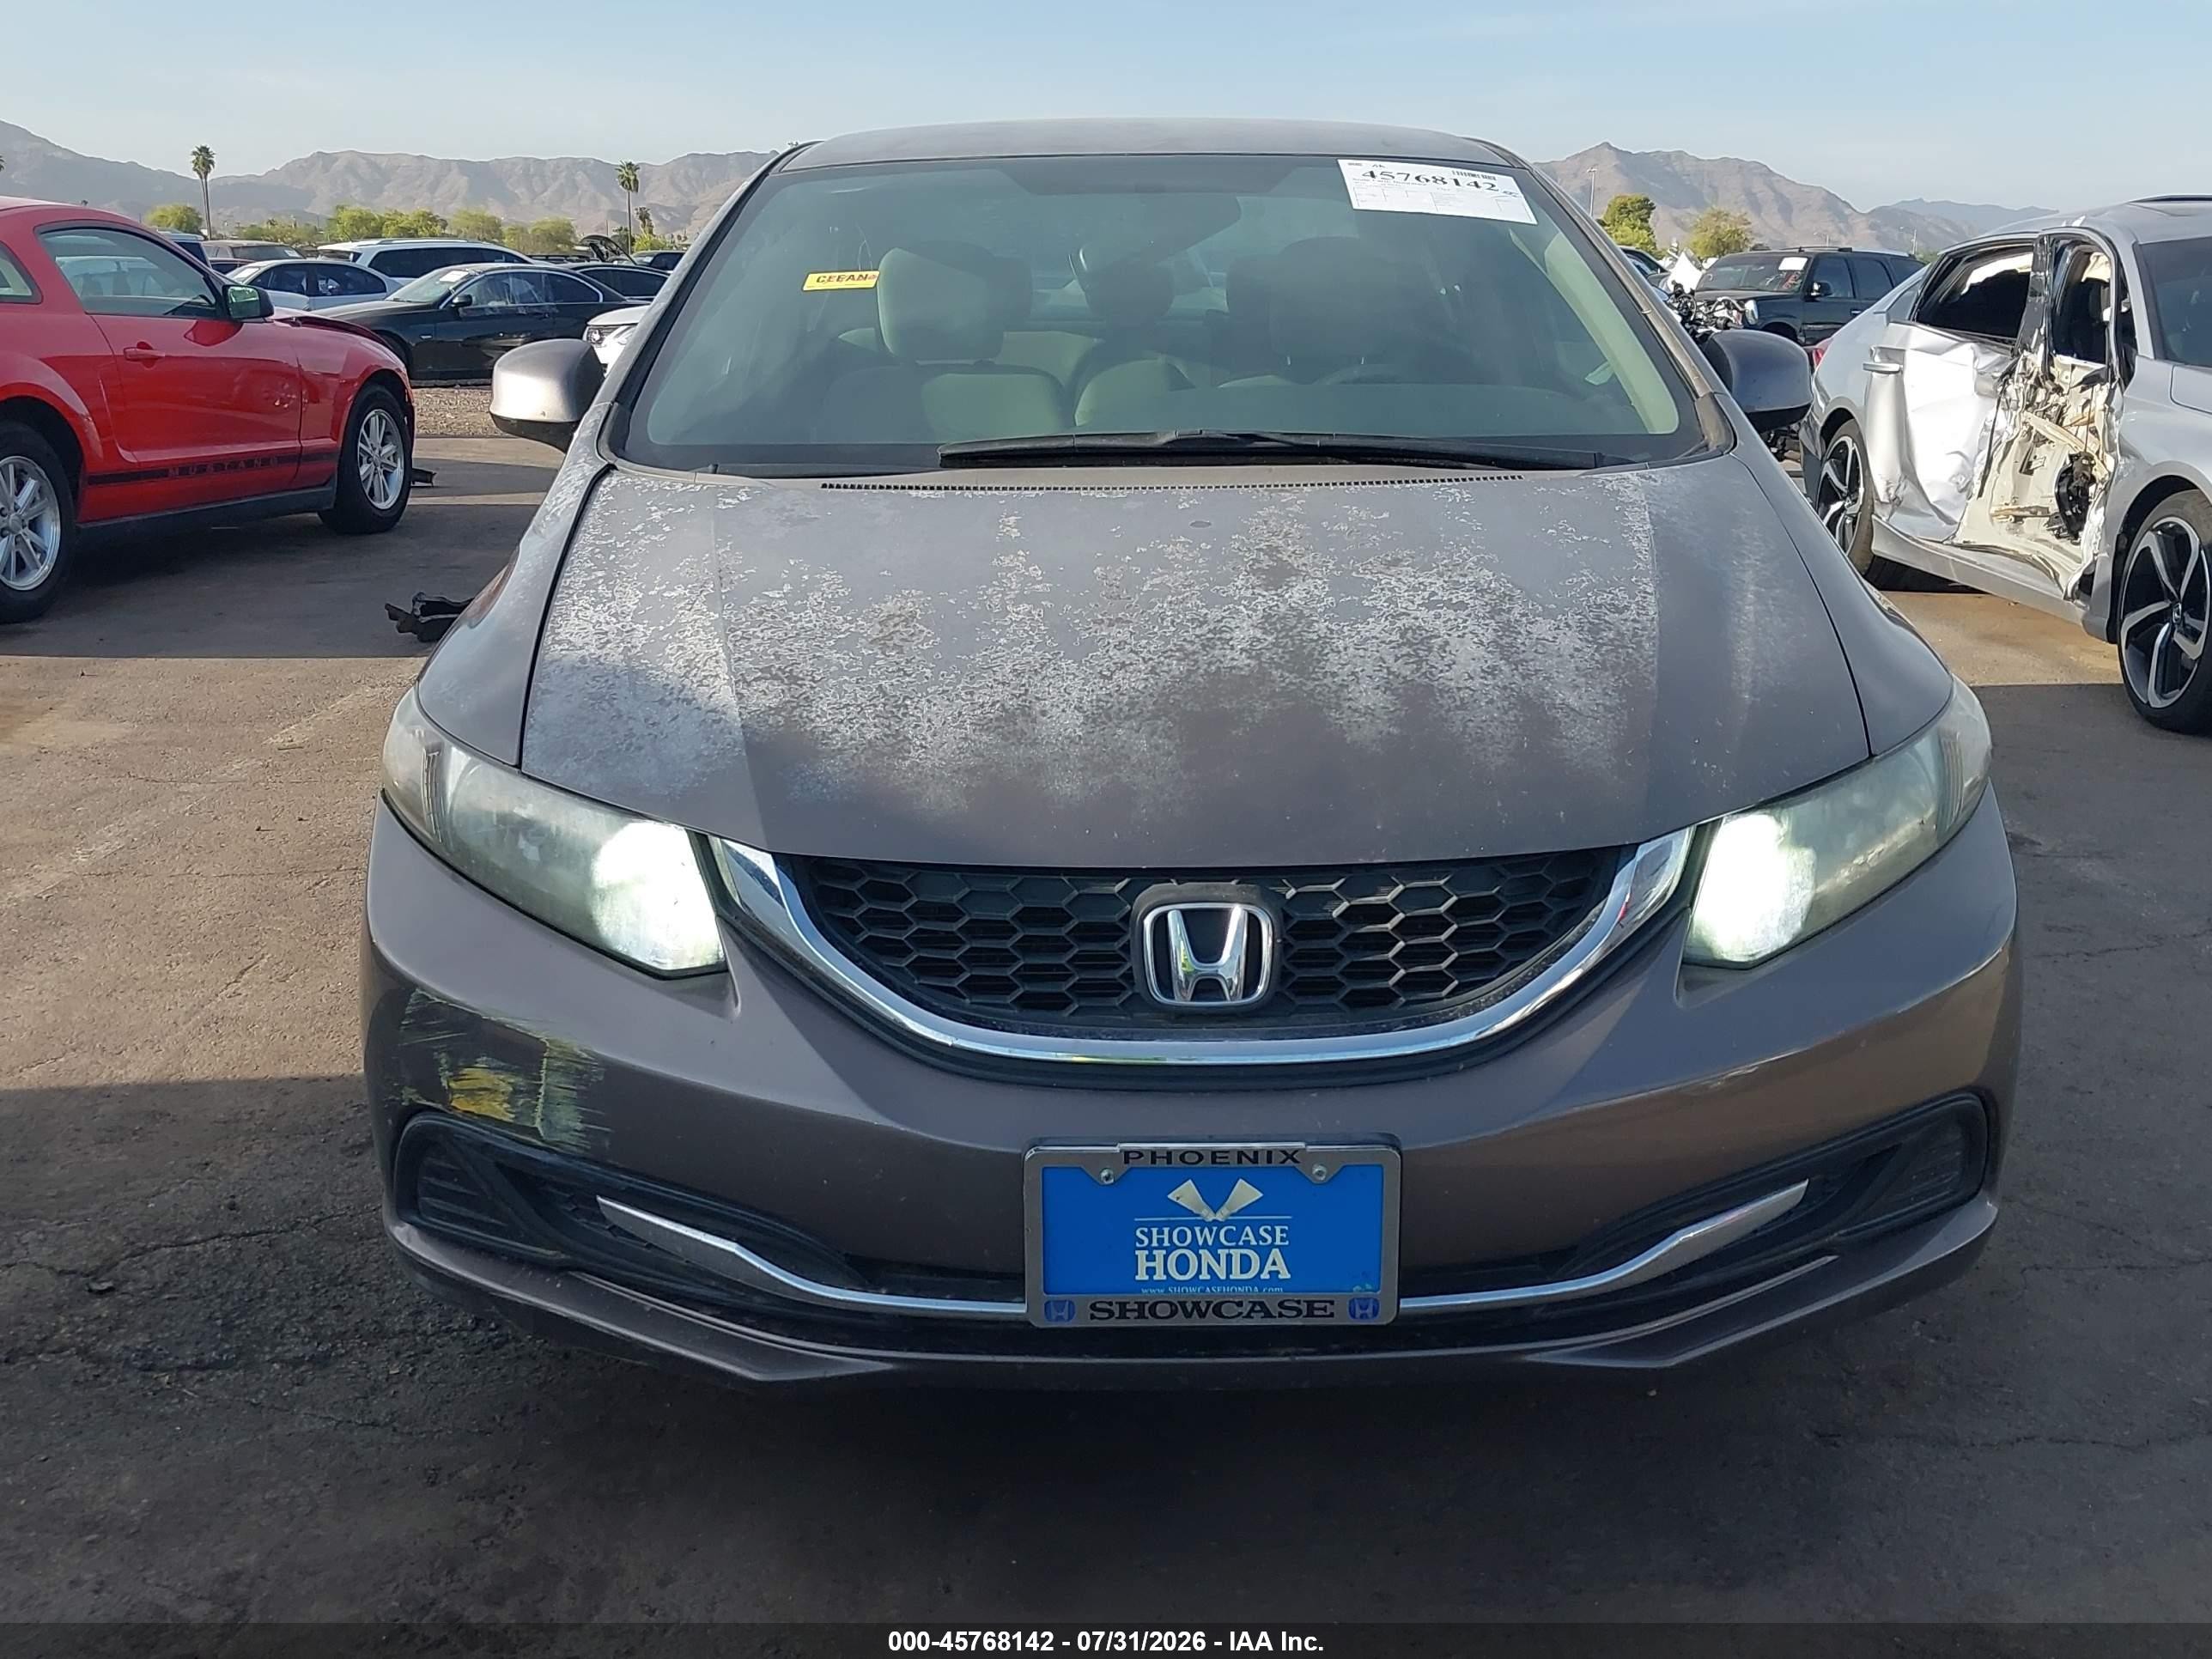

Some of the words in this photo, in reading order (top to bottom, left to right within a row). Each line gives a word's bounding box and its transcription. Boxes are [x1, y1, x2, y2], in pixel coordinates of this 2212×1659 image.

[1361, 170, 1499, 192] 45768142
[168, 457, 279, 477] MUSTANG
[1122, 1149, 1303, 1165] PHOENIX
[1134, 1224, 1290, 1248] SHOWCASE
[1134, 1248, 1291, 1281] HONDA
[1089, 1299, 1335, 1321] SHOWCASE
